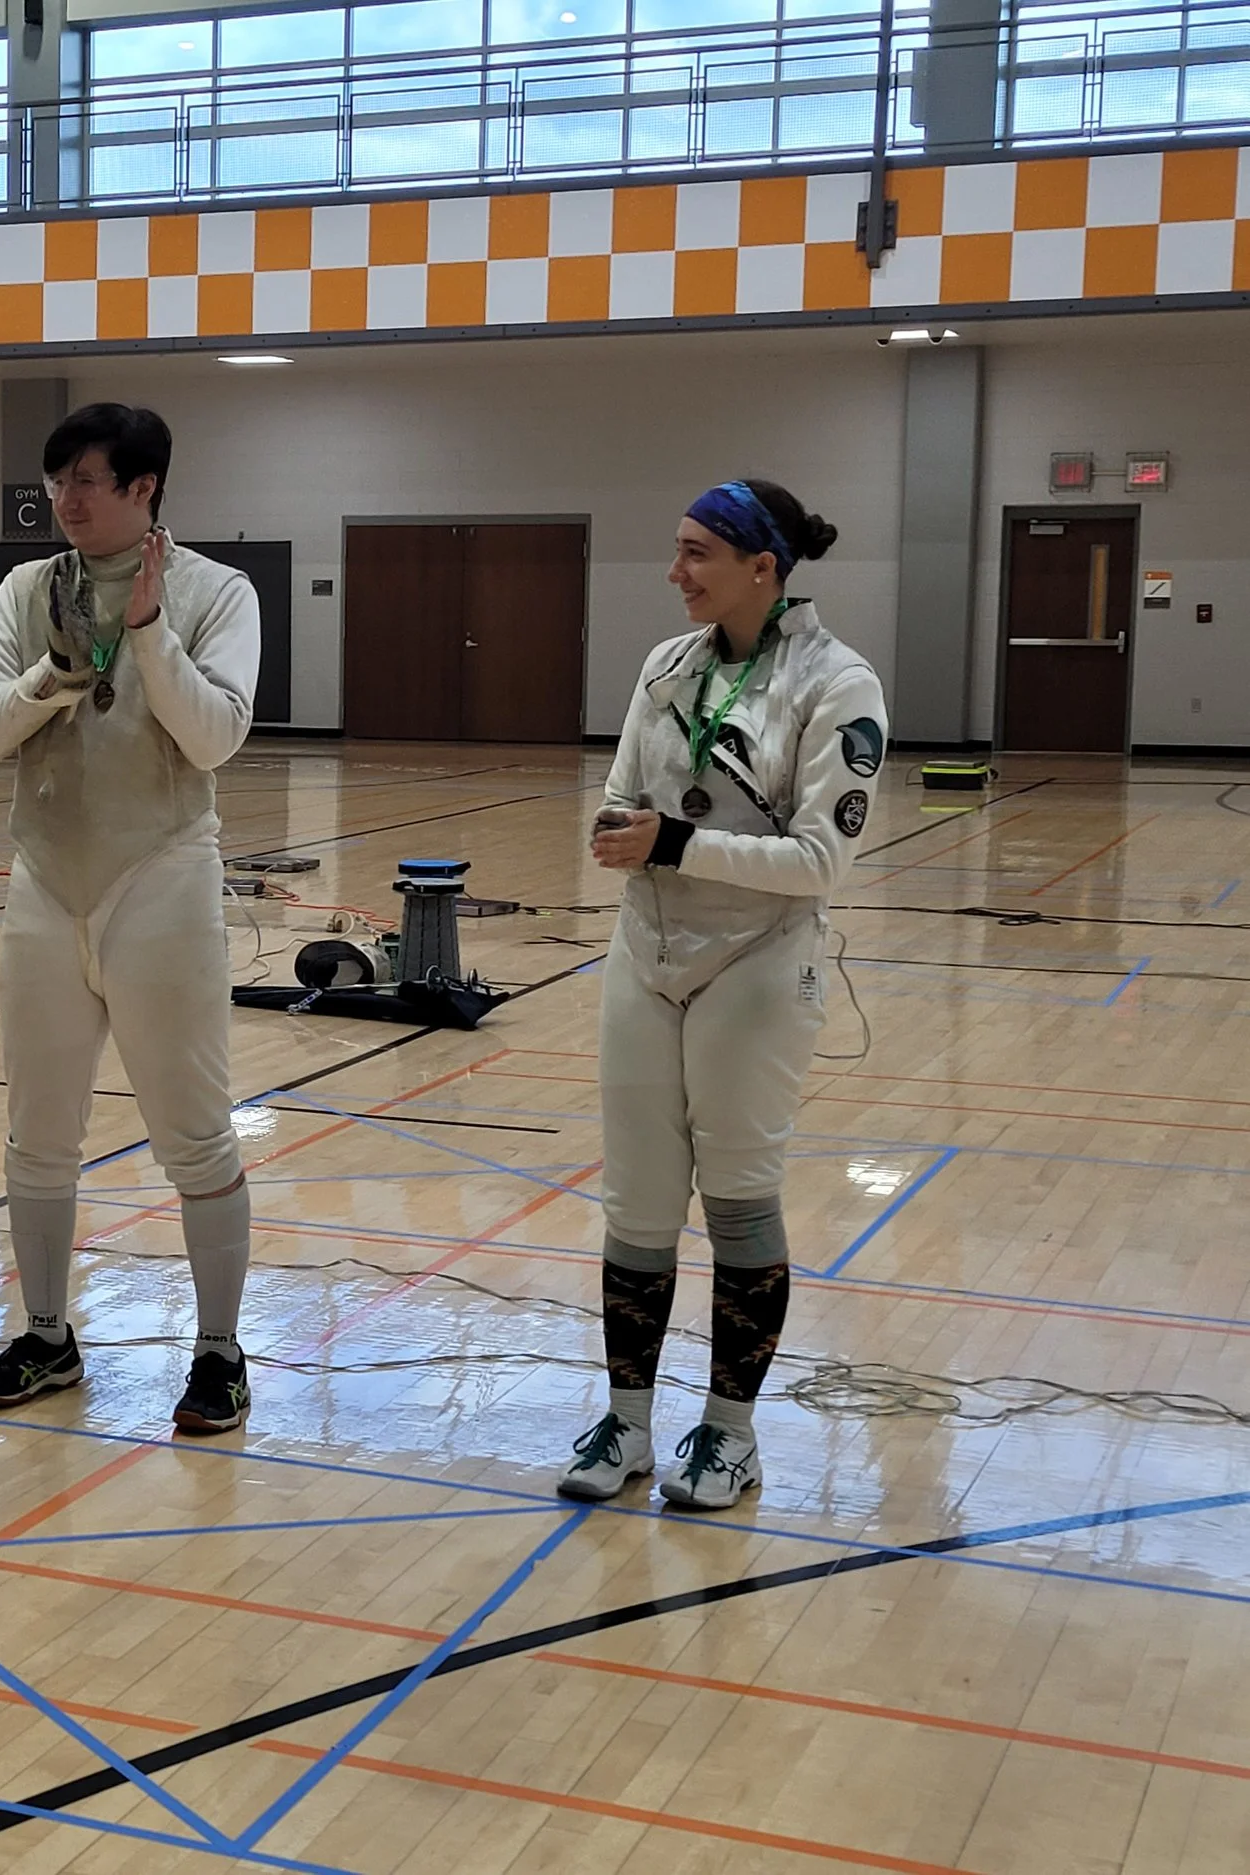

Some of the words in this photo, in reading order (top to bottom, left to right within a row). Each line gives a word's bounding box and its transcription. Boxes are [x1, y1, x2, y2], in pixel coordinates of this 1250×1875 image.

[15, 488, 39, 499] GYM
[18, 502, 37, 527] C
[200, 1331, 228, 1342] Leon
